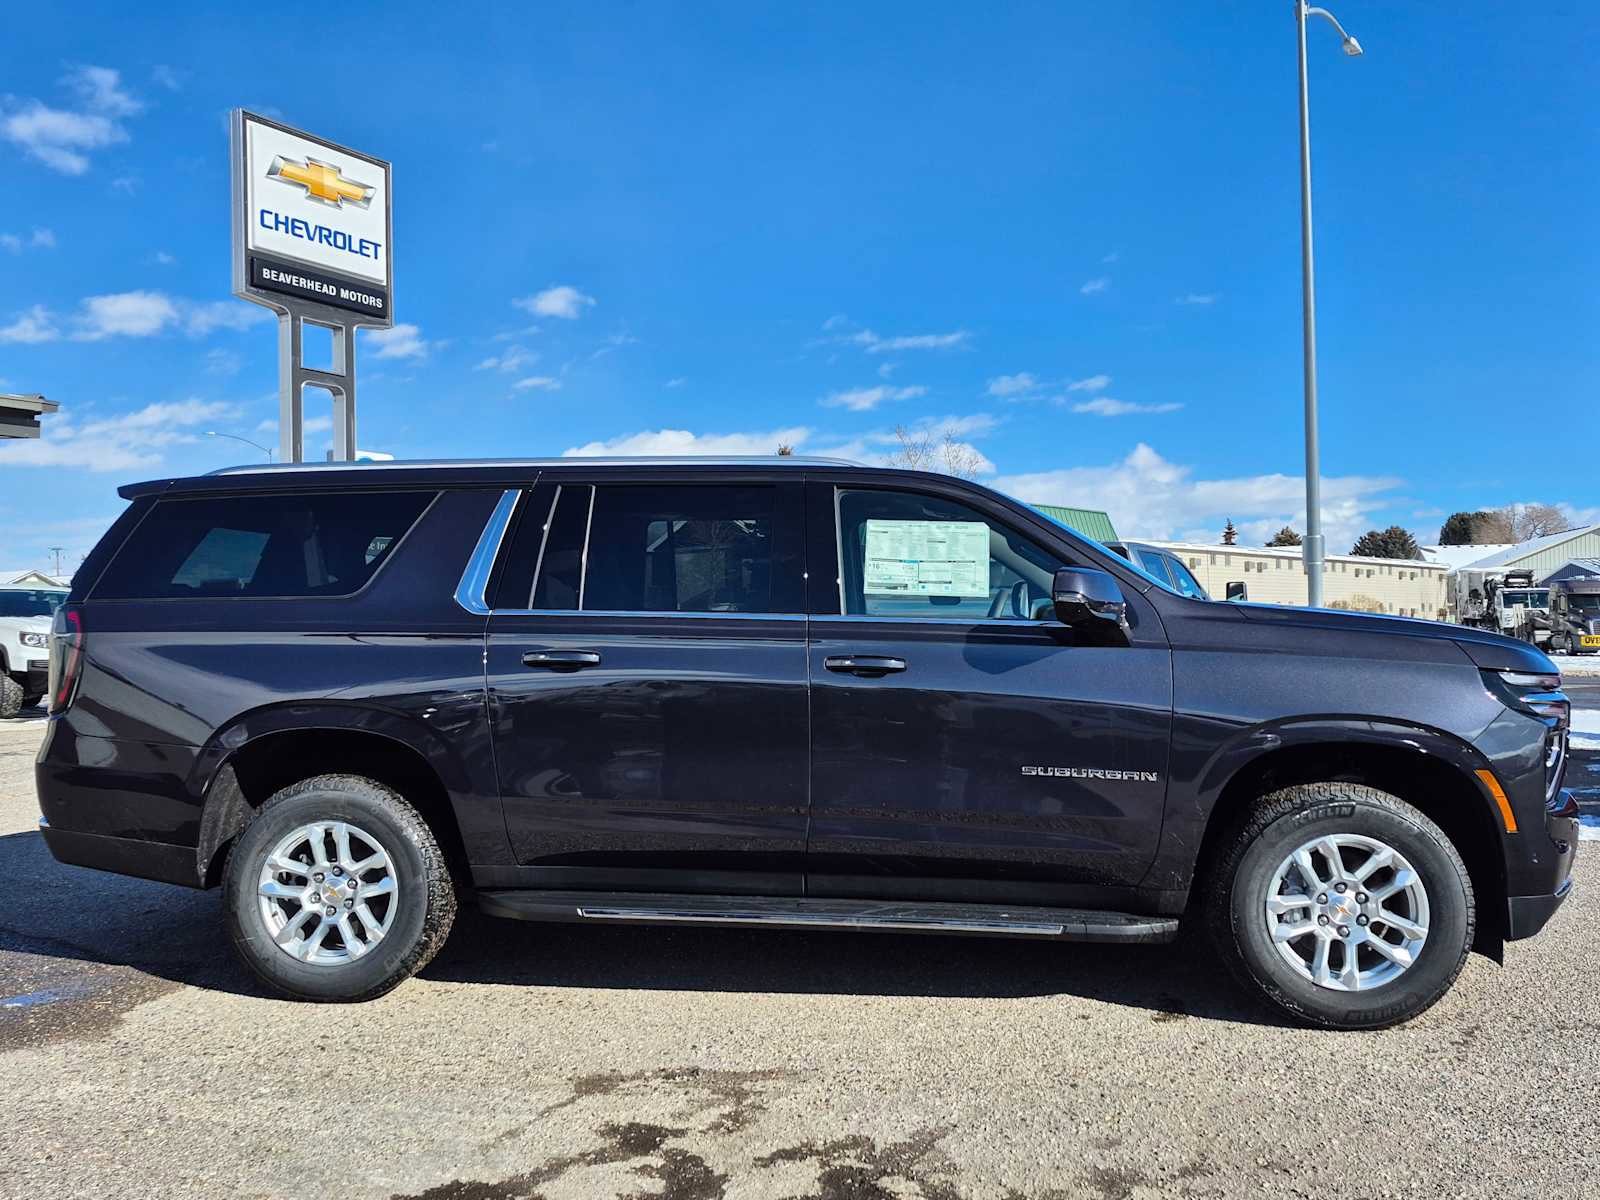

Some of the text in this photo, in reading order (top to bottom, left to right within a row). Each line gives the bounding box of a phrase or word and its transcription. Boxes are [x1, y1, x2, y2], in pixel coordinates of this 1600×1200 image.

[260, 209, 382, 260] CHEVROLET
[262, 268, 383, 309] BEAVERHEAD MOTORS
[1021, 766, 1158, 782] SUBURBAN
